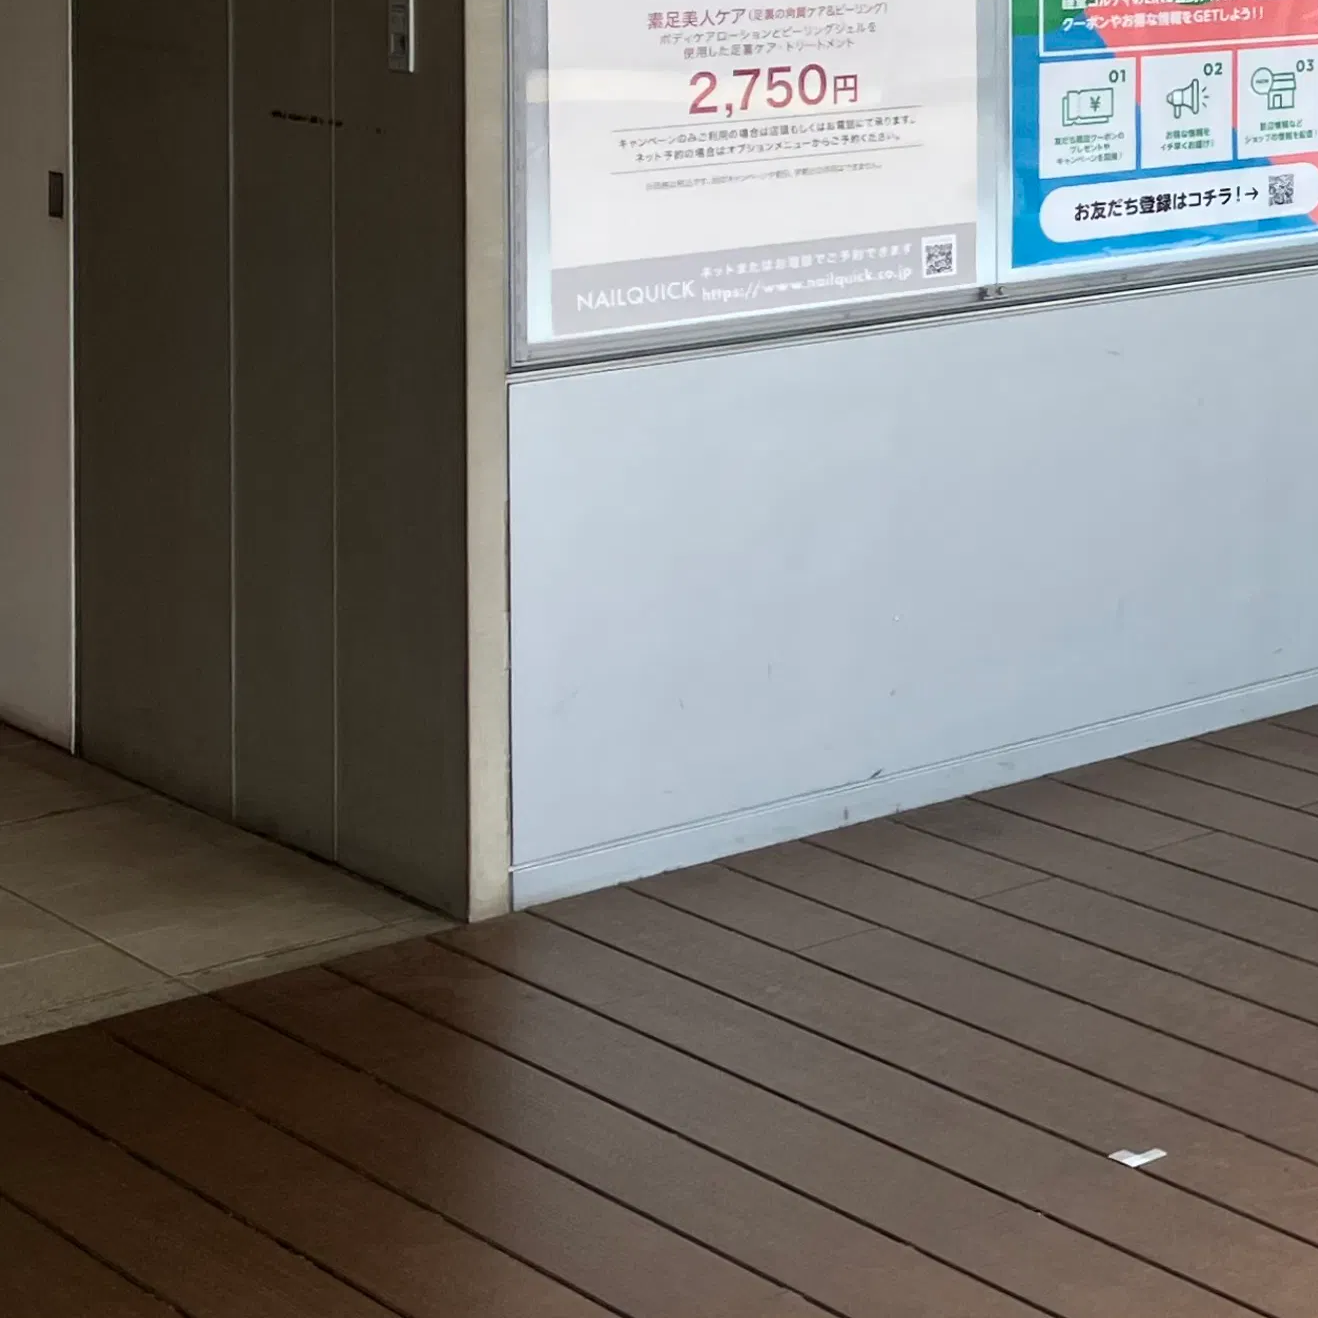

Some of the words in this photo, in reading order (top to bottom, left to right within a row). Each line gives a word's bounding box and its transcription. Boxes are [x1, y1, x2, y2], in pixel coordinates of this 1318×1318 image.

[1203, 62, 1224, 76] 02
[1295, 58, 1315, 72] 03
[1108, 68, 1127, 83] 01
[689, 63, 859, 118] 2,750円
[576, 279, 695, 312] NAILQUICK
